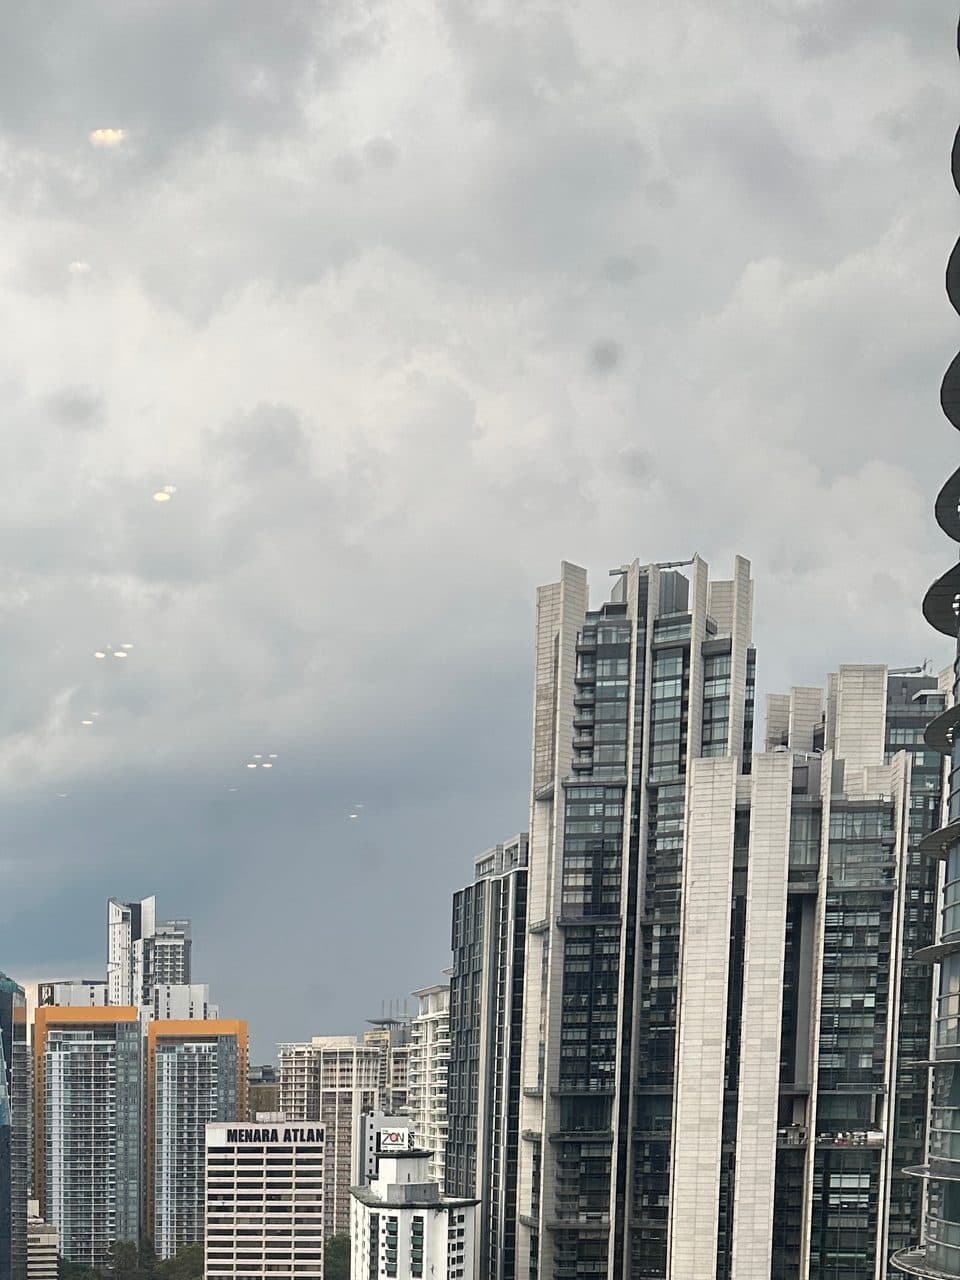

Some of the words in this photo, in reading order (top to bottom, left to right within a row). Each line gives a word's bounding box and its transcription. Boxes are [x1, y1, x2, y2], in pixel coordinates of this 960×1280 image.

[226, 1128, 279, 1143] MENARA
[283, 1128, 325, 1143] ATLAN
[382, 1132, 405, 1145] ZON
